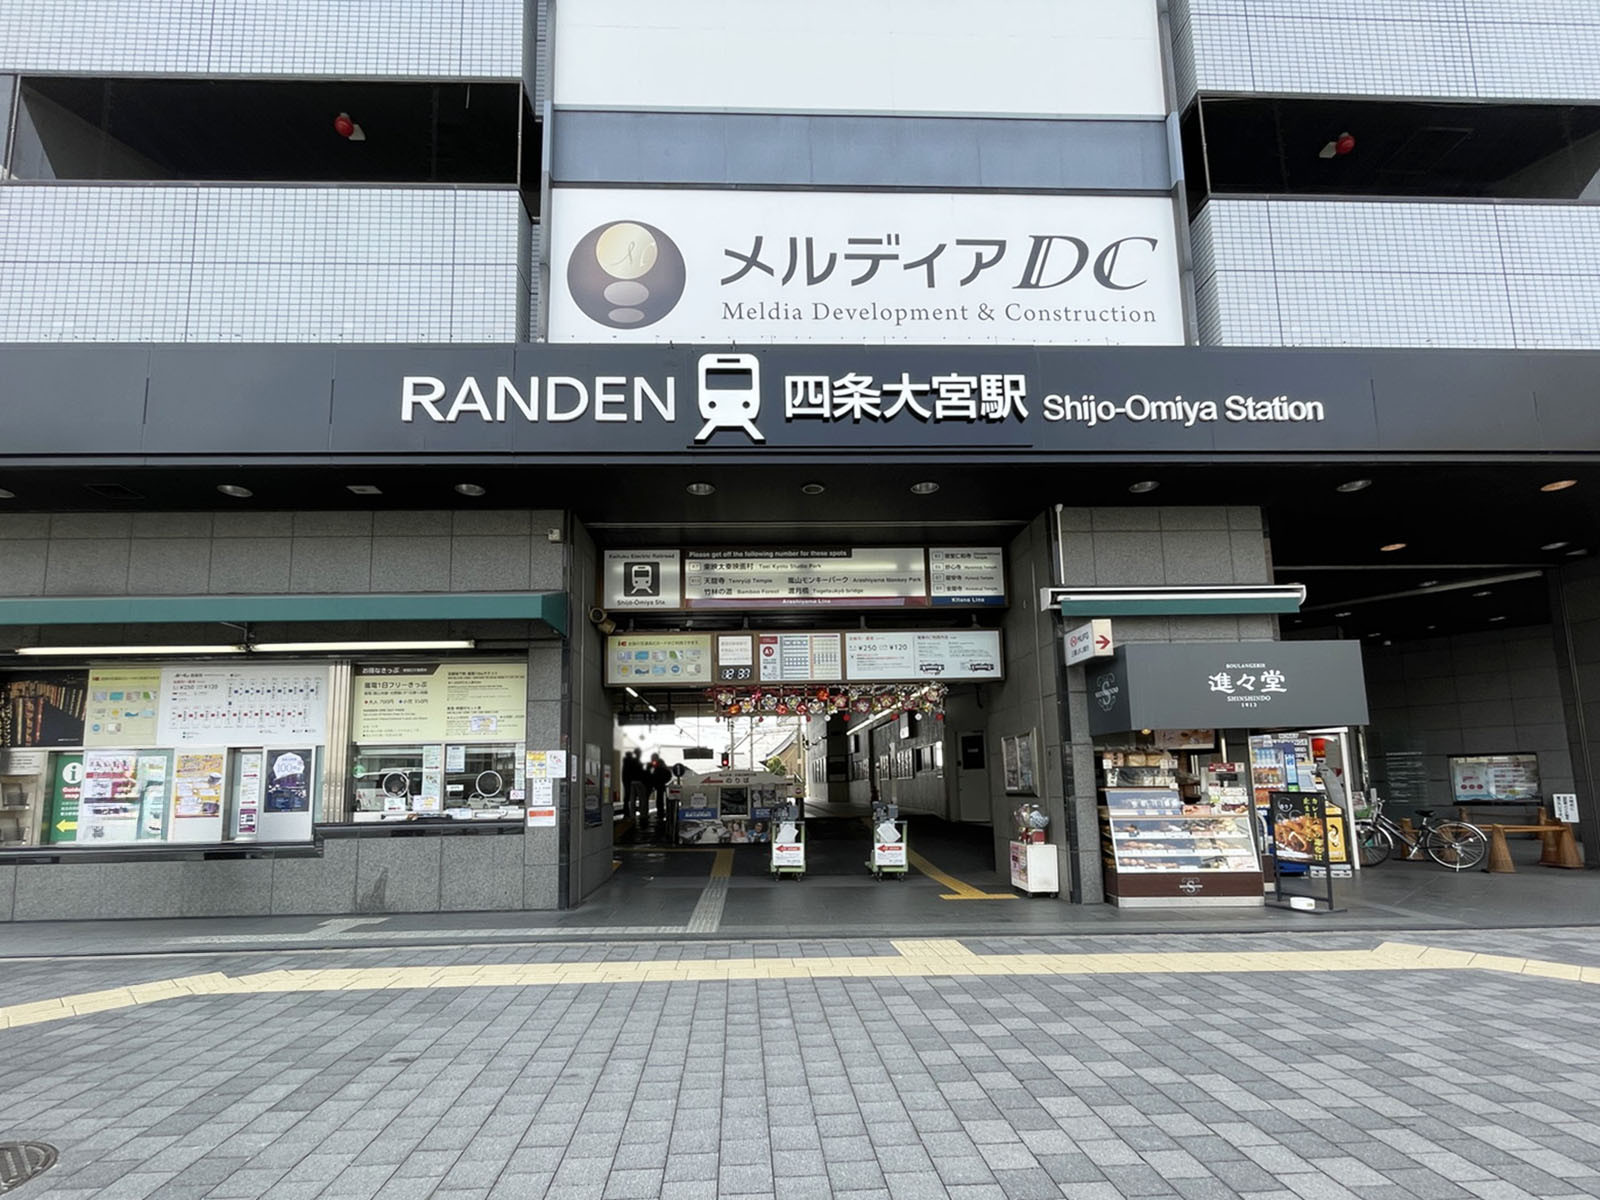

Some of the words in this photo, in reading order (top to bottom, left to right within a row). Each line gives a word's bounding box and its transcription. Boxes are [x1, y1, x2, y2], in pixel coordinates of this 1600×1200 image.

[723, 302, 802, 320] Meldia
[813, 302, 967, 326] Development
[978, 302, 995, 321] &
[1005, 303, 1156, 323] Construction
[401, 376, 676, 422] RANDEN
[784, 373, 1028, 420] 四条大宮駅
[1043, 395, 1218, 427] Shijo-Omiya
[1225, 395, 1325, 421] Station
[688, 552, 710, 560] Please
[744, 551, 773, 560] following
[1208, 669, 1288, 694] 進々堂
